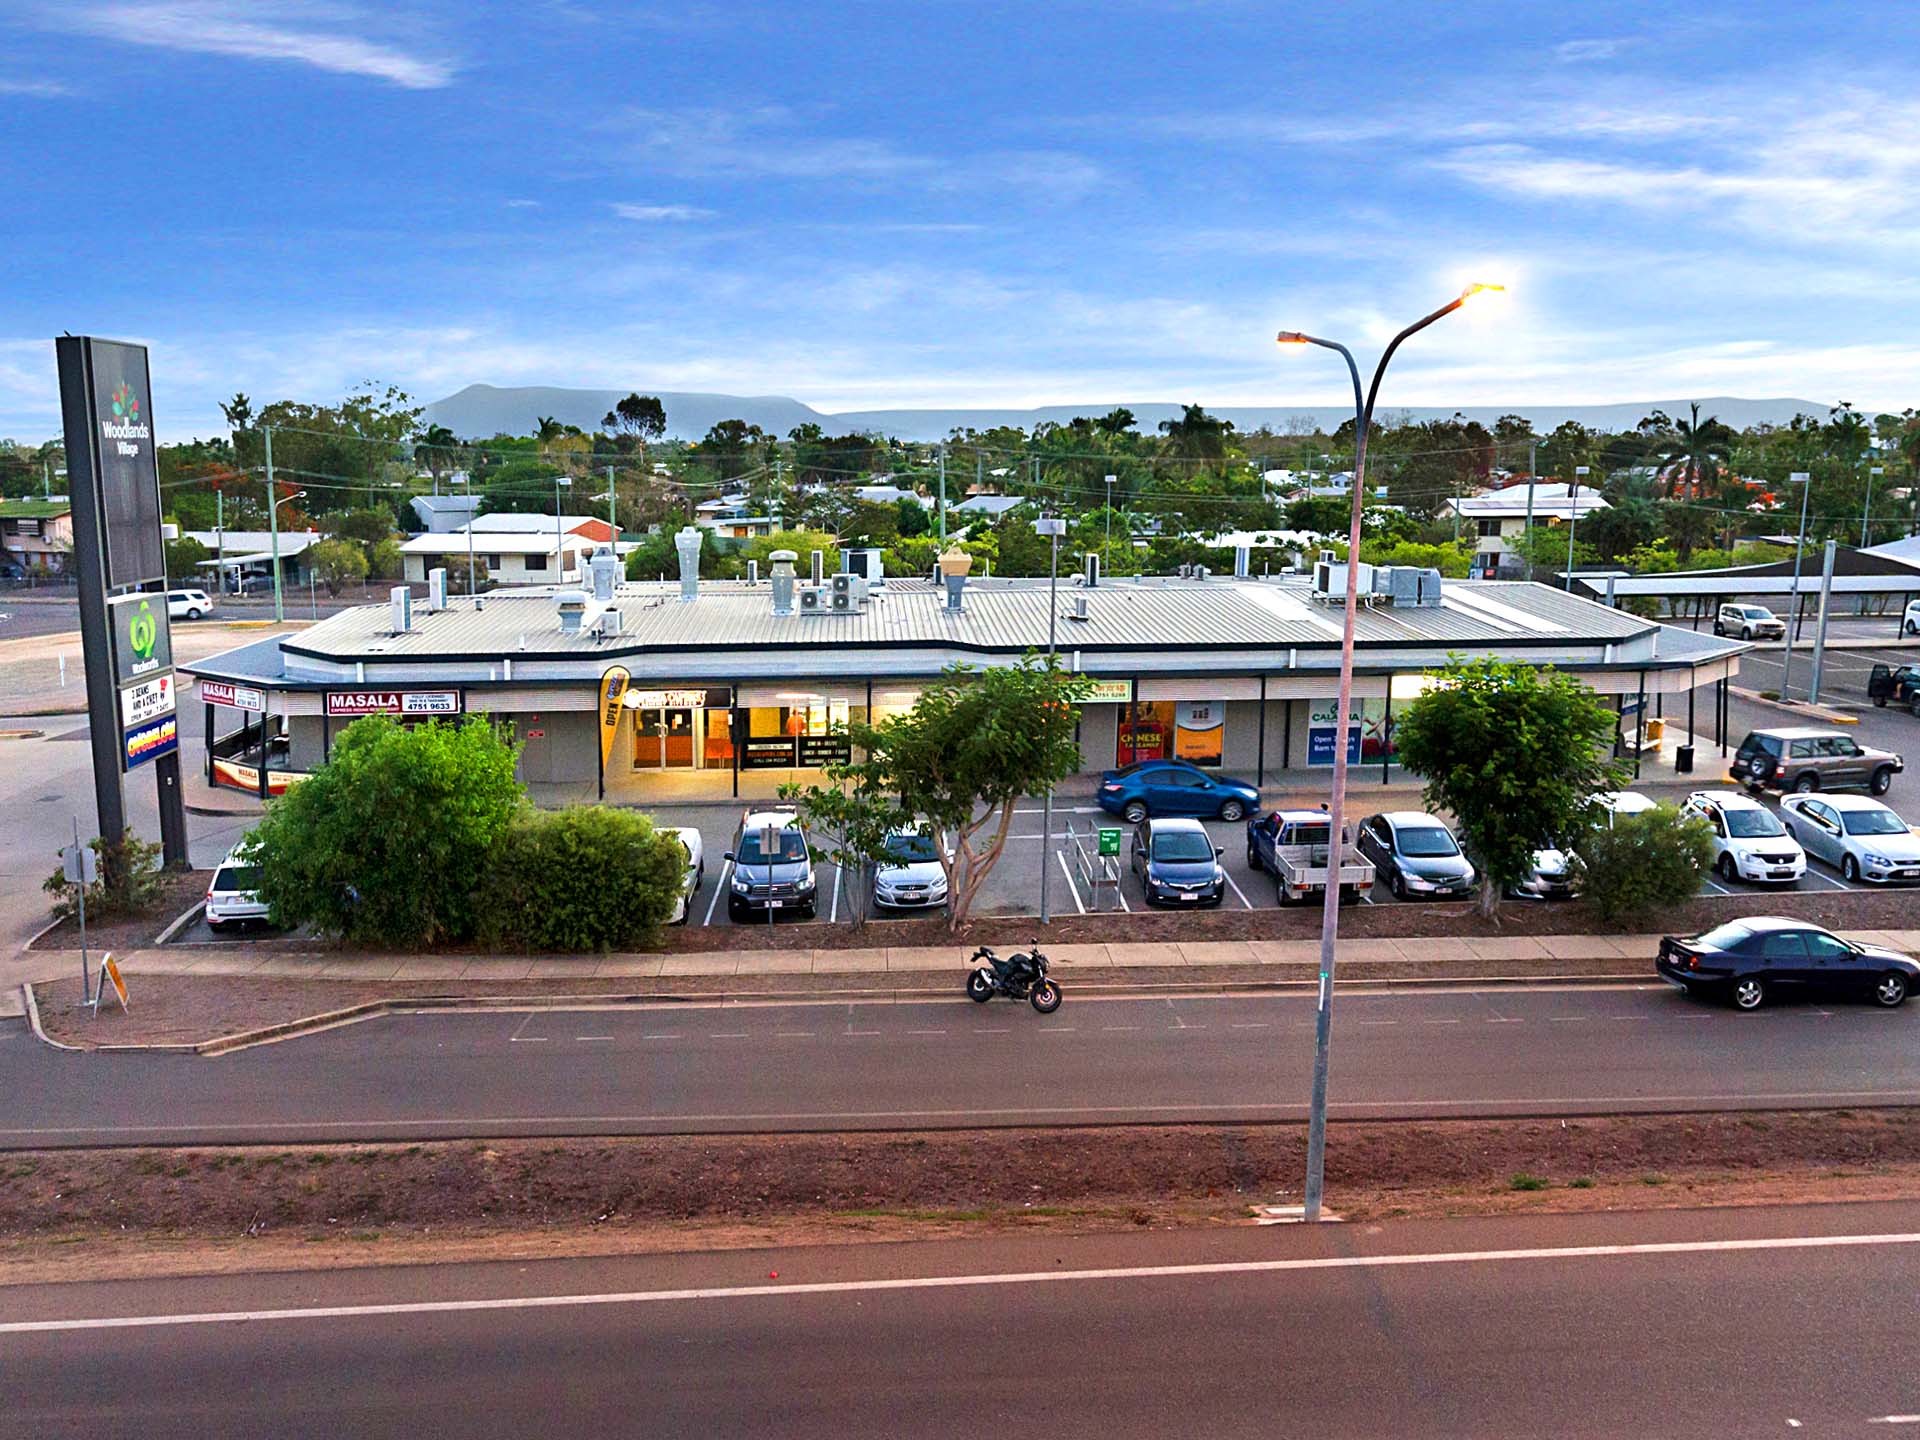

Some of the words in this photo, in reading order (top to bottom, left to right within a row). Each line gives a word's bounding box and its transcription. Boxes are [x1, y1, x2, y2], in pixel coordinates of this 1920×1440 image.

[102, 416, 149, 439] Woodlands
[116, 441, 139, 458] Village
[203, 683, 234, 700] MASALA
[330, 694, 400, 707] MASALA
[605, 702, 619, 726] OPEN
[1312, 713, 1360, 721] CALAA
[1120, 733, 1161, 742] CHNESE
